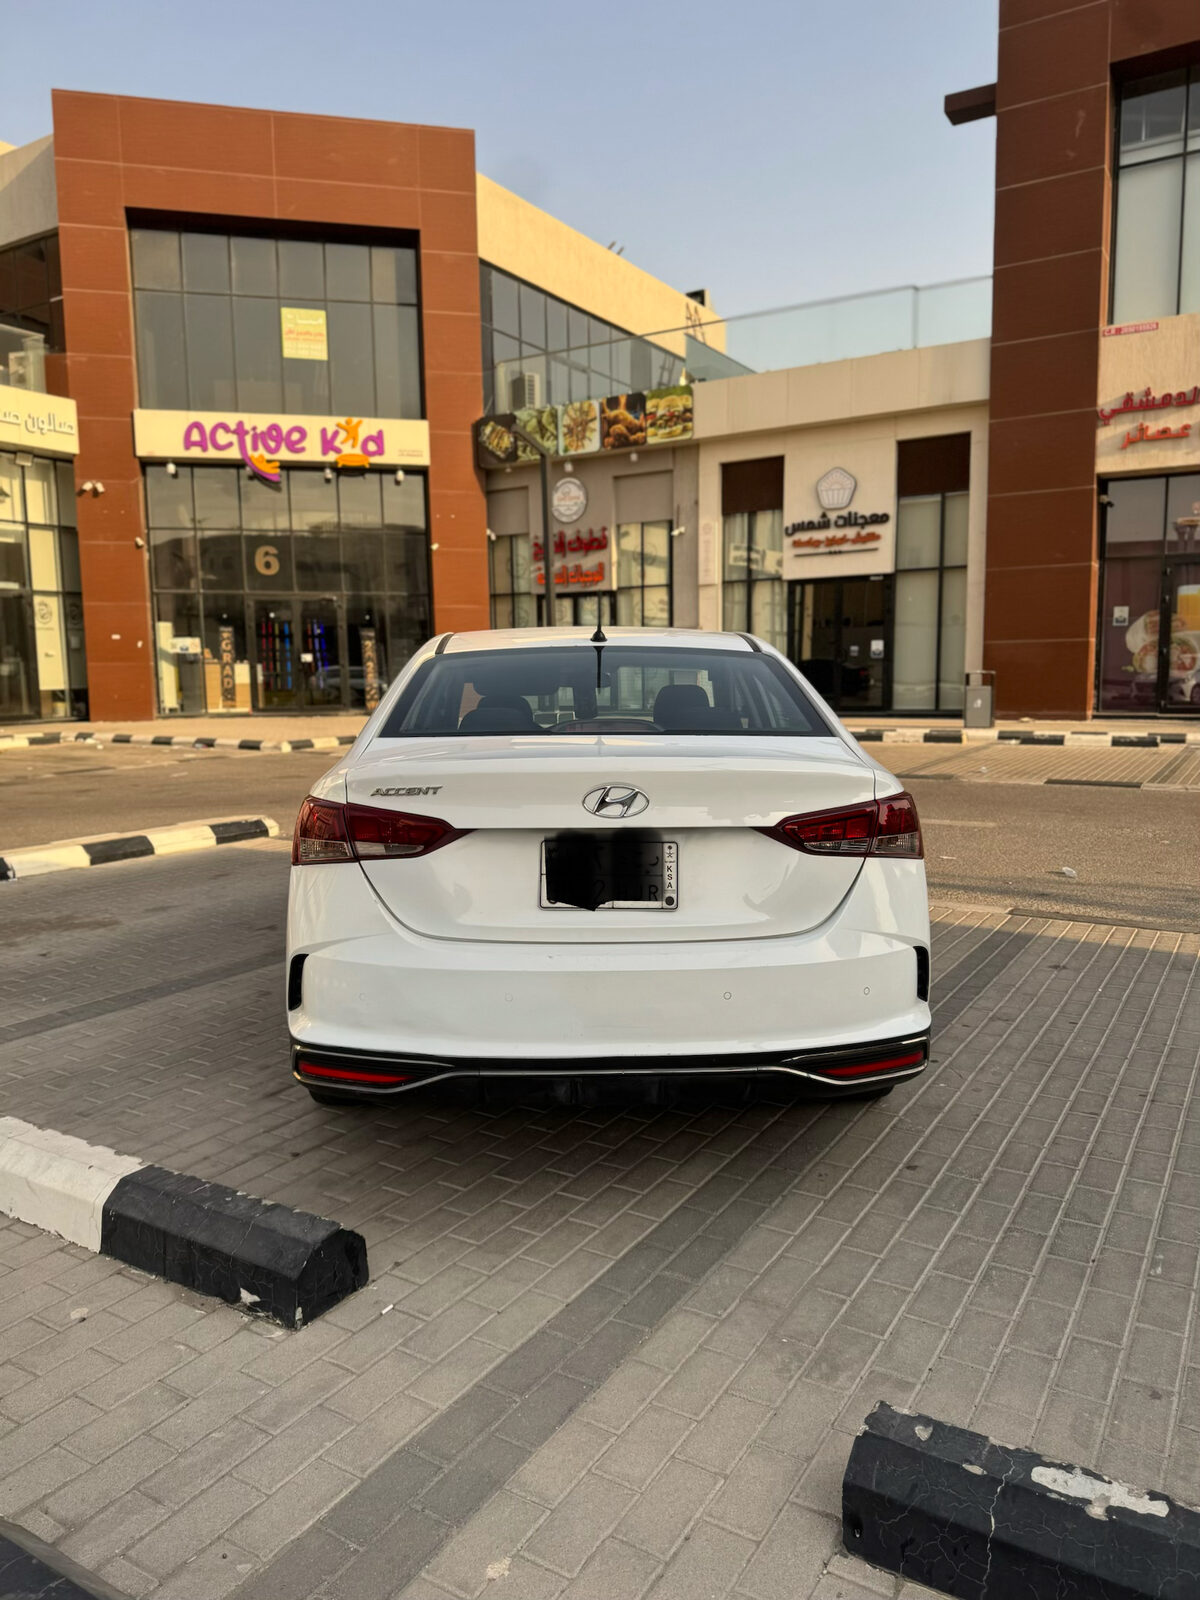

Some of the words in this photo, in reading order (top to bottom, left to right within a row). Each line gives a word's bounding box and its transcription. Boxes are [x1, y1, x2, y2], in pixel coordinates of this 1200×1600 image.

[1100, 386, 1200, 426] لدمشقي
[1120, 422, 1192, 450] عصائر
[784, 511, 831, 537] شمس
[834, 511, 890, 530] معجنات
[254, 545, 280, 576] 6
[370, 786, 443, 797] ACCENT
